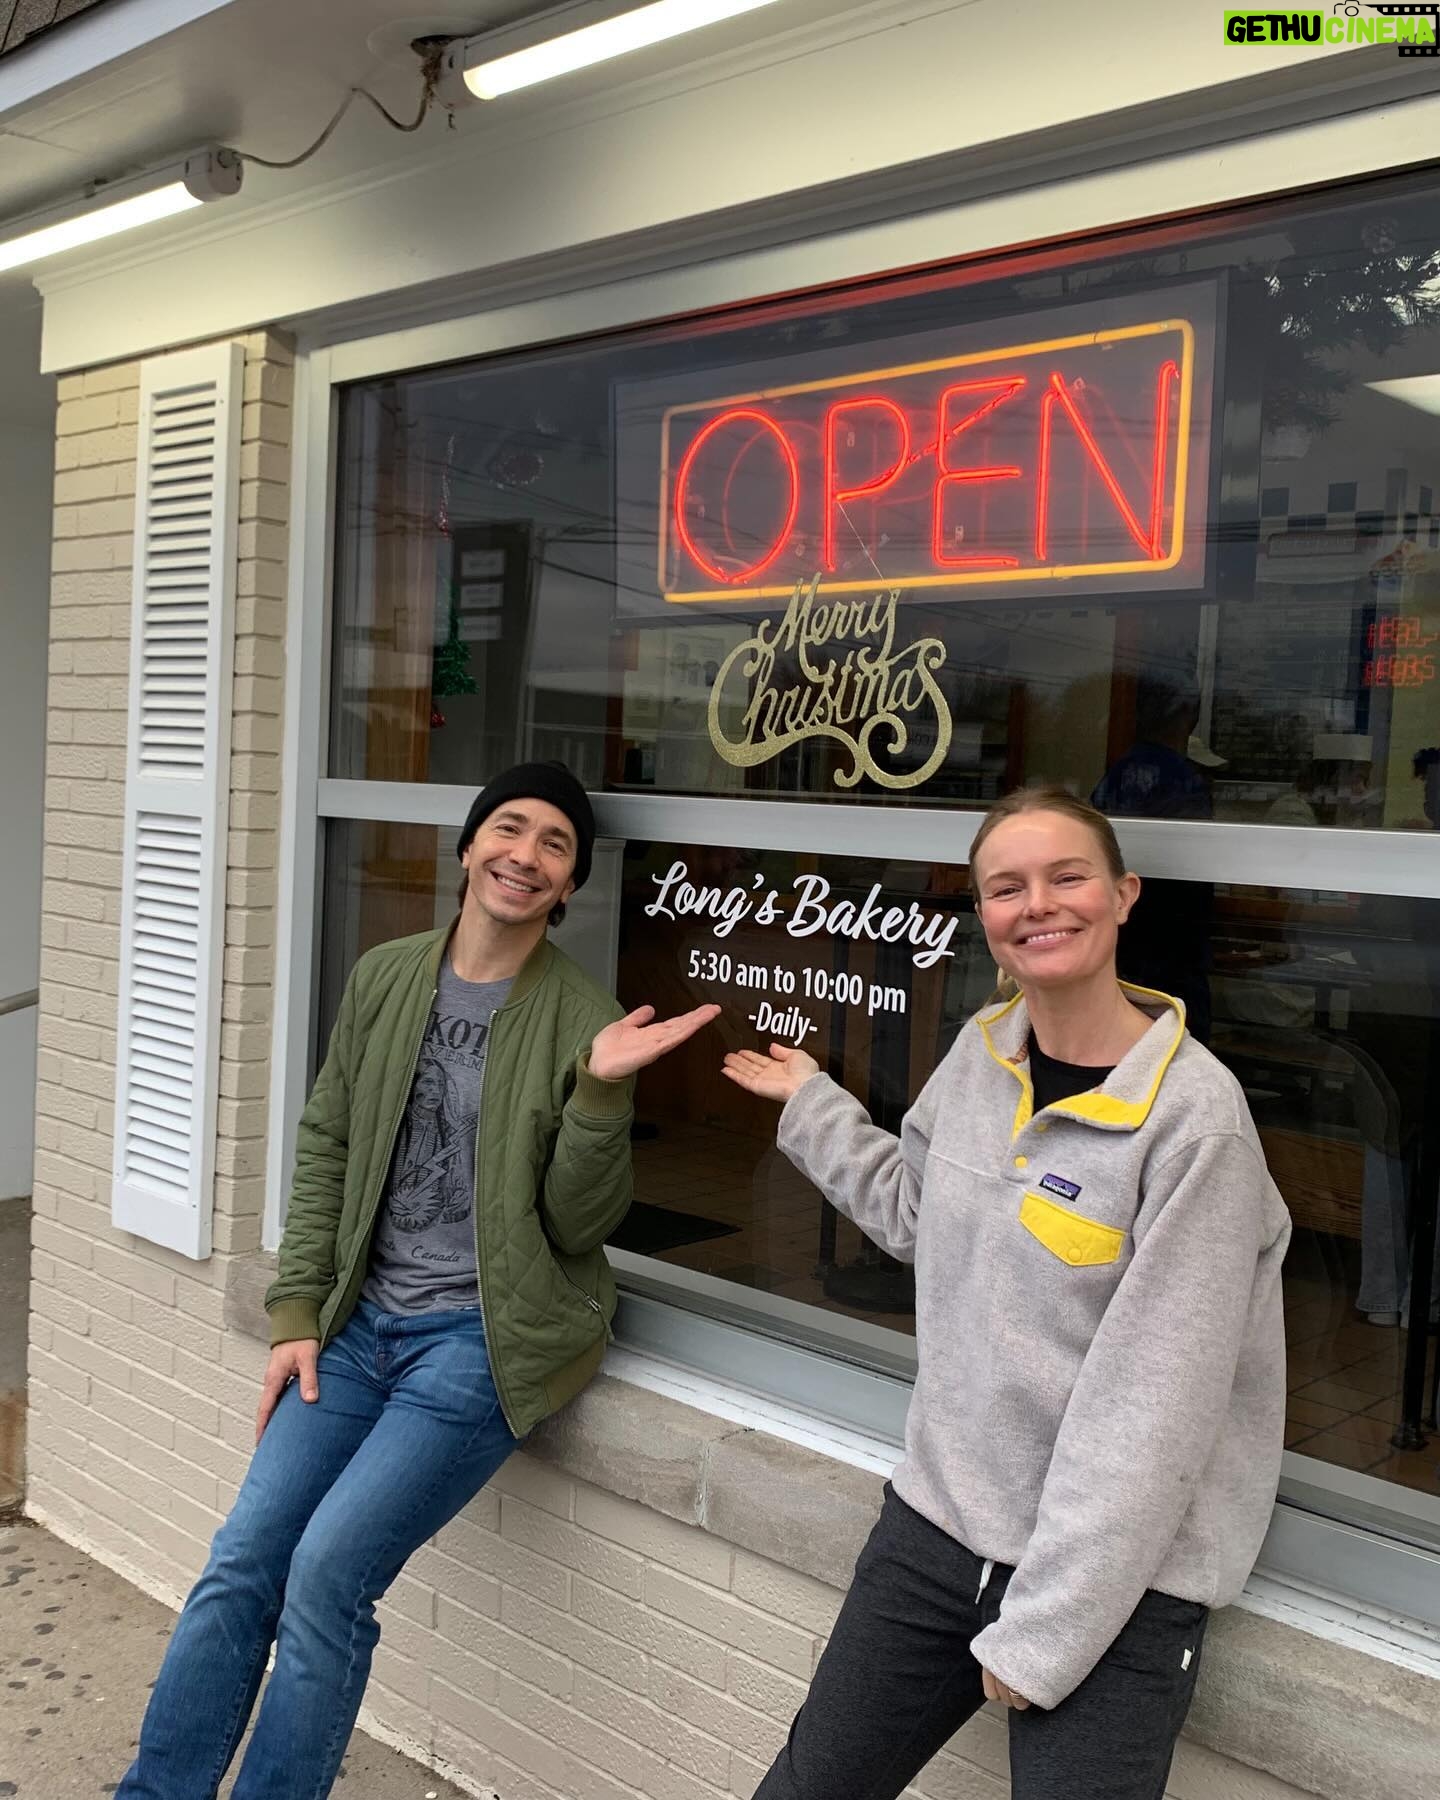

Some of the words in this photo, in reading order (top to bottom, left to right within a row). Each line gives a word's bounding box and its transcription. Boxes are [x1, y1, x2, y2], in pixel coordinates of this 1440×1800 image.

[674, 359, 1178, 584] OPEN
[758, 571, 902, 668] Merry
[708, 638, 952, 789] Christmas
[644, 860, 785, 938] Long's
[786, 873, 960, 969] Bakery
[687, 949, 732, 984] 5:30
[735, 959, 769, 990] am
[773, 964, 796, 994] to
[802, 967, 863, 1006] 10:00
[868, 983, 907, 1017] pm
[748, 1002, 819, 1047] -Daily-
[411, 1244, 461, 1263] Canada
